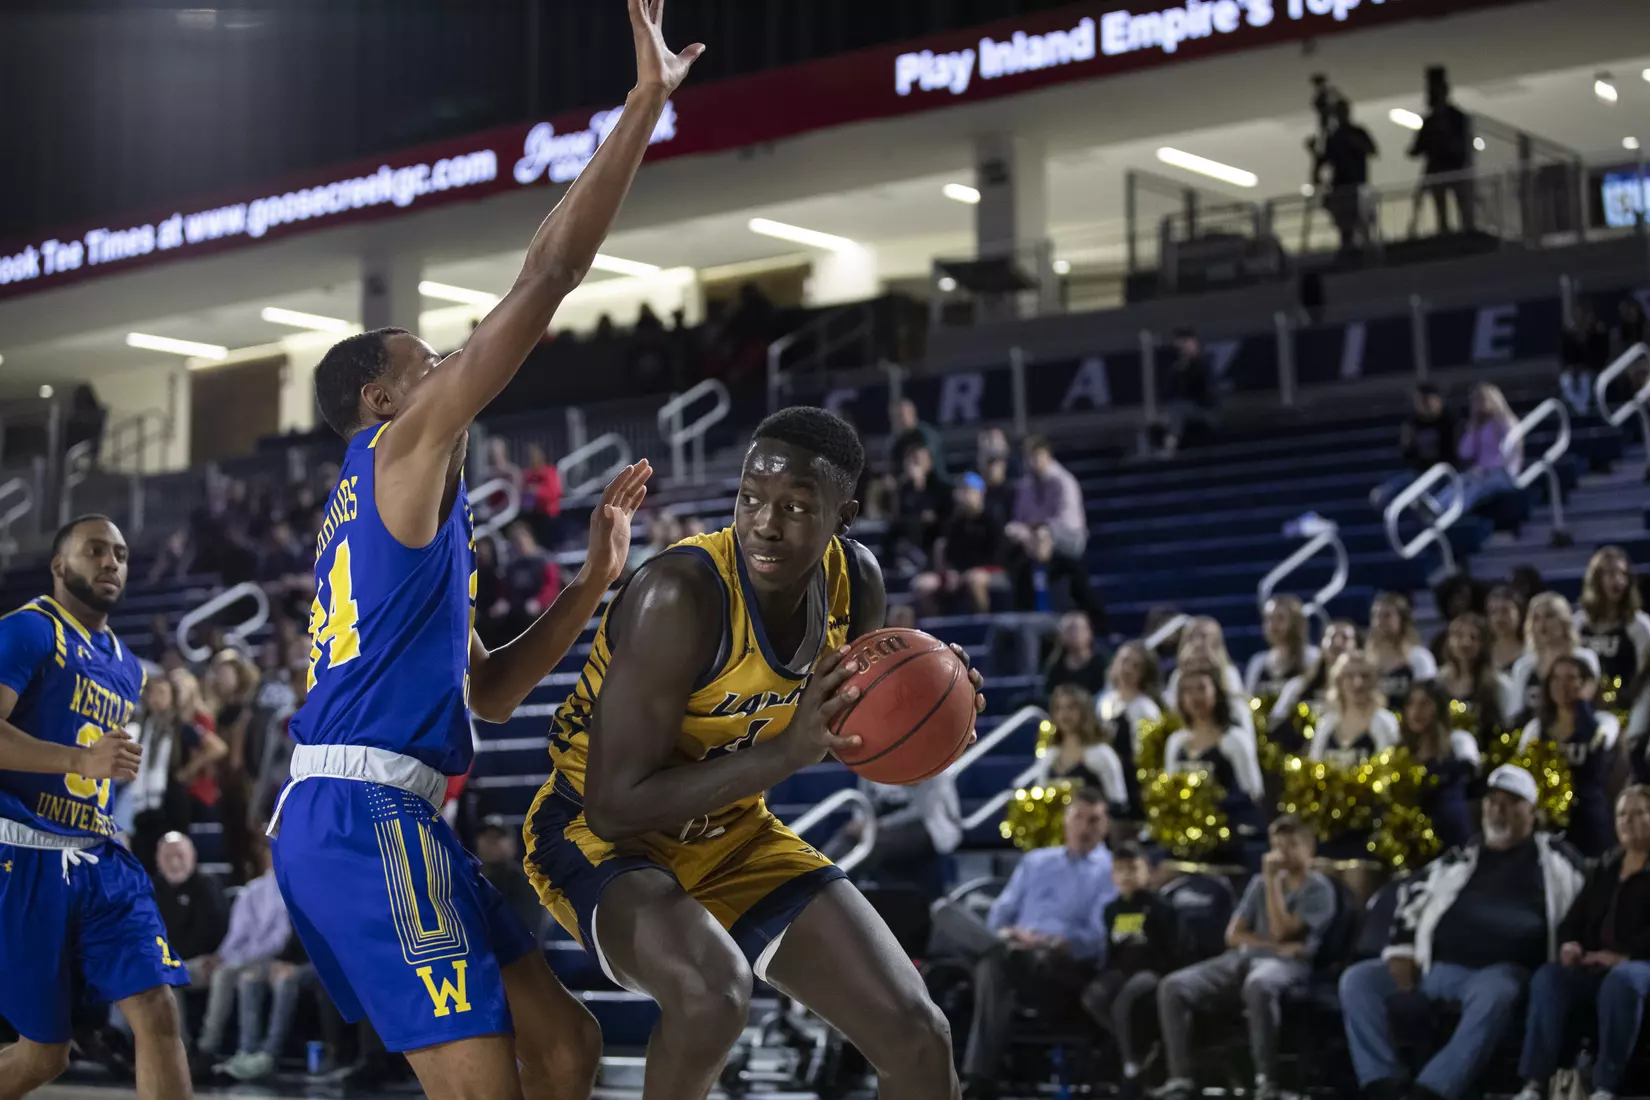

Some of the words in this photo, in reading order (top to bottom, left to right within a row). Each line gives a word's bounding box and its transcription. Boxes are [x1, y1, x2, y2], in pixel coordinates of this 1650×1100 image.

[895, 48, 976, 96] Play
[979, 17, 1096, 79] Inland
[1100, 0, 1275, 56] Empire's
[41, 239, 84, 275] Tee
[84, 223, 156, 266] Times
[156, 212, 184, 251] at
[184, 149, 498, 245] www.goosecreekgc.com
[416, 960, 472, 1018] W
